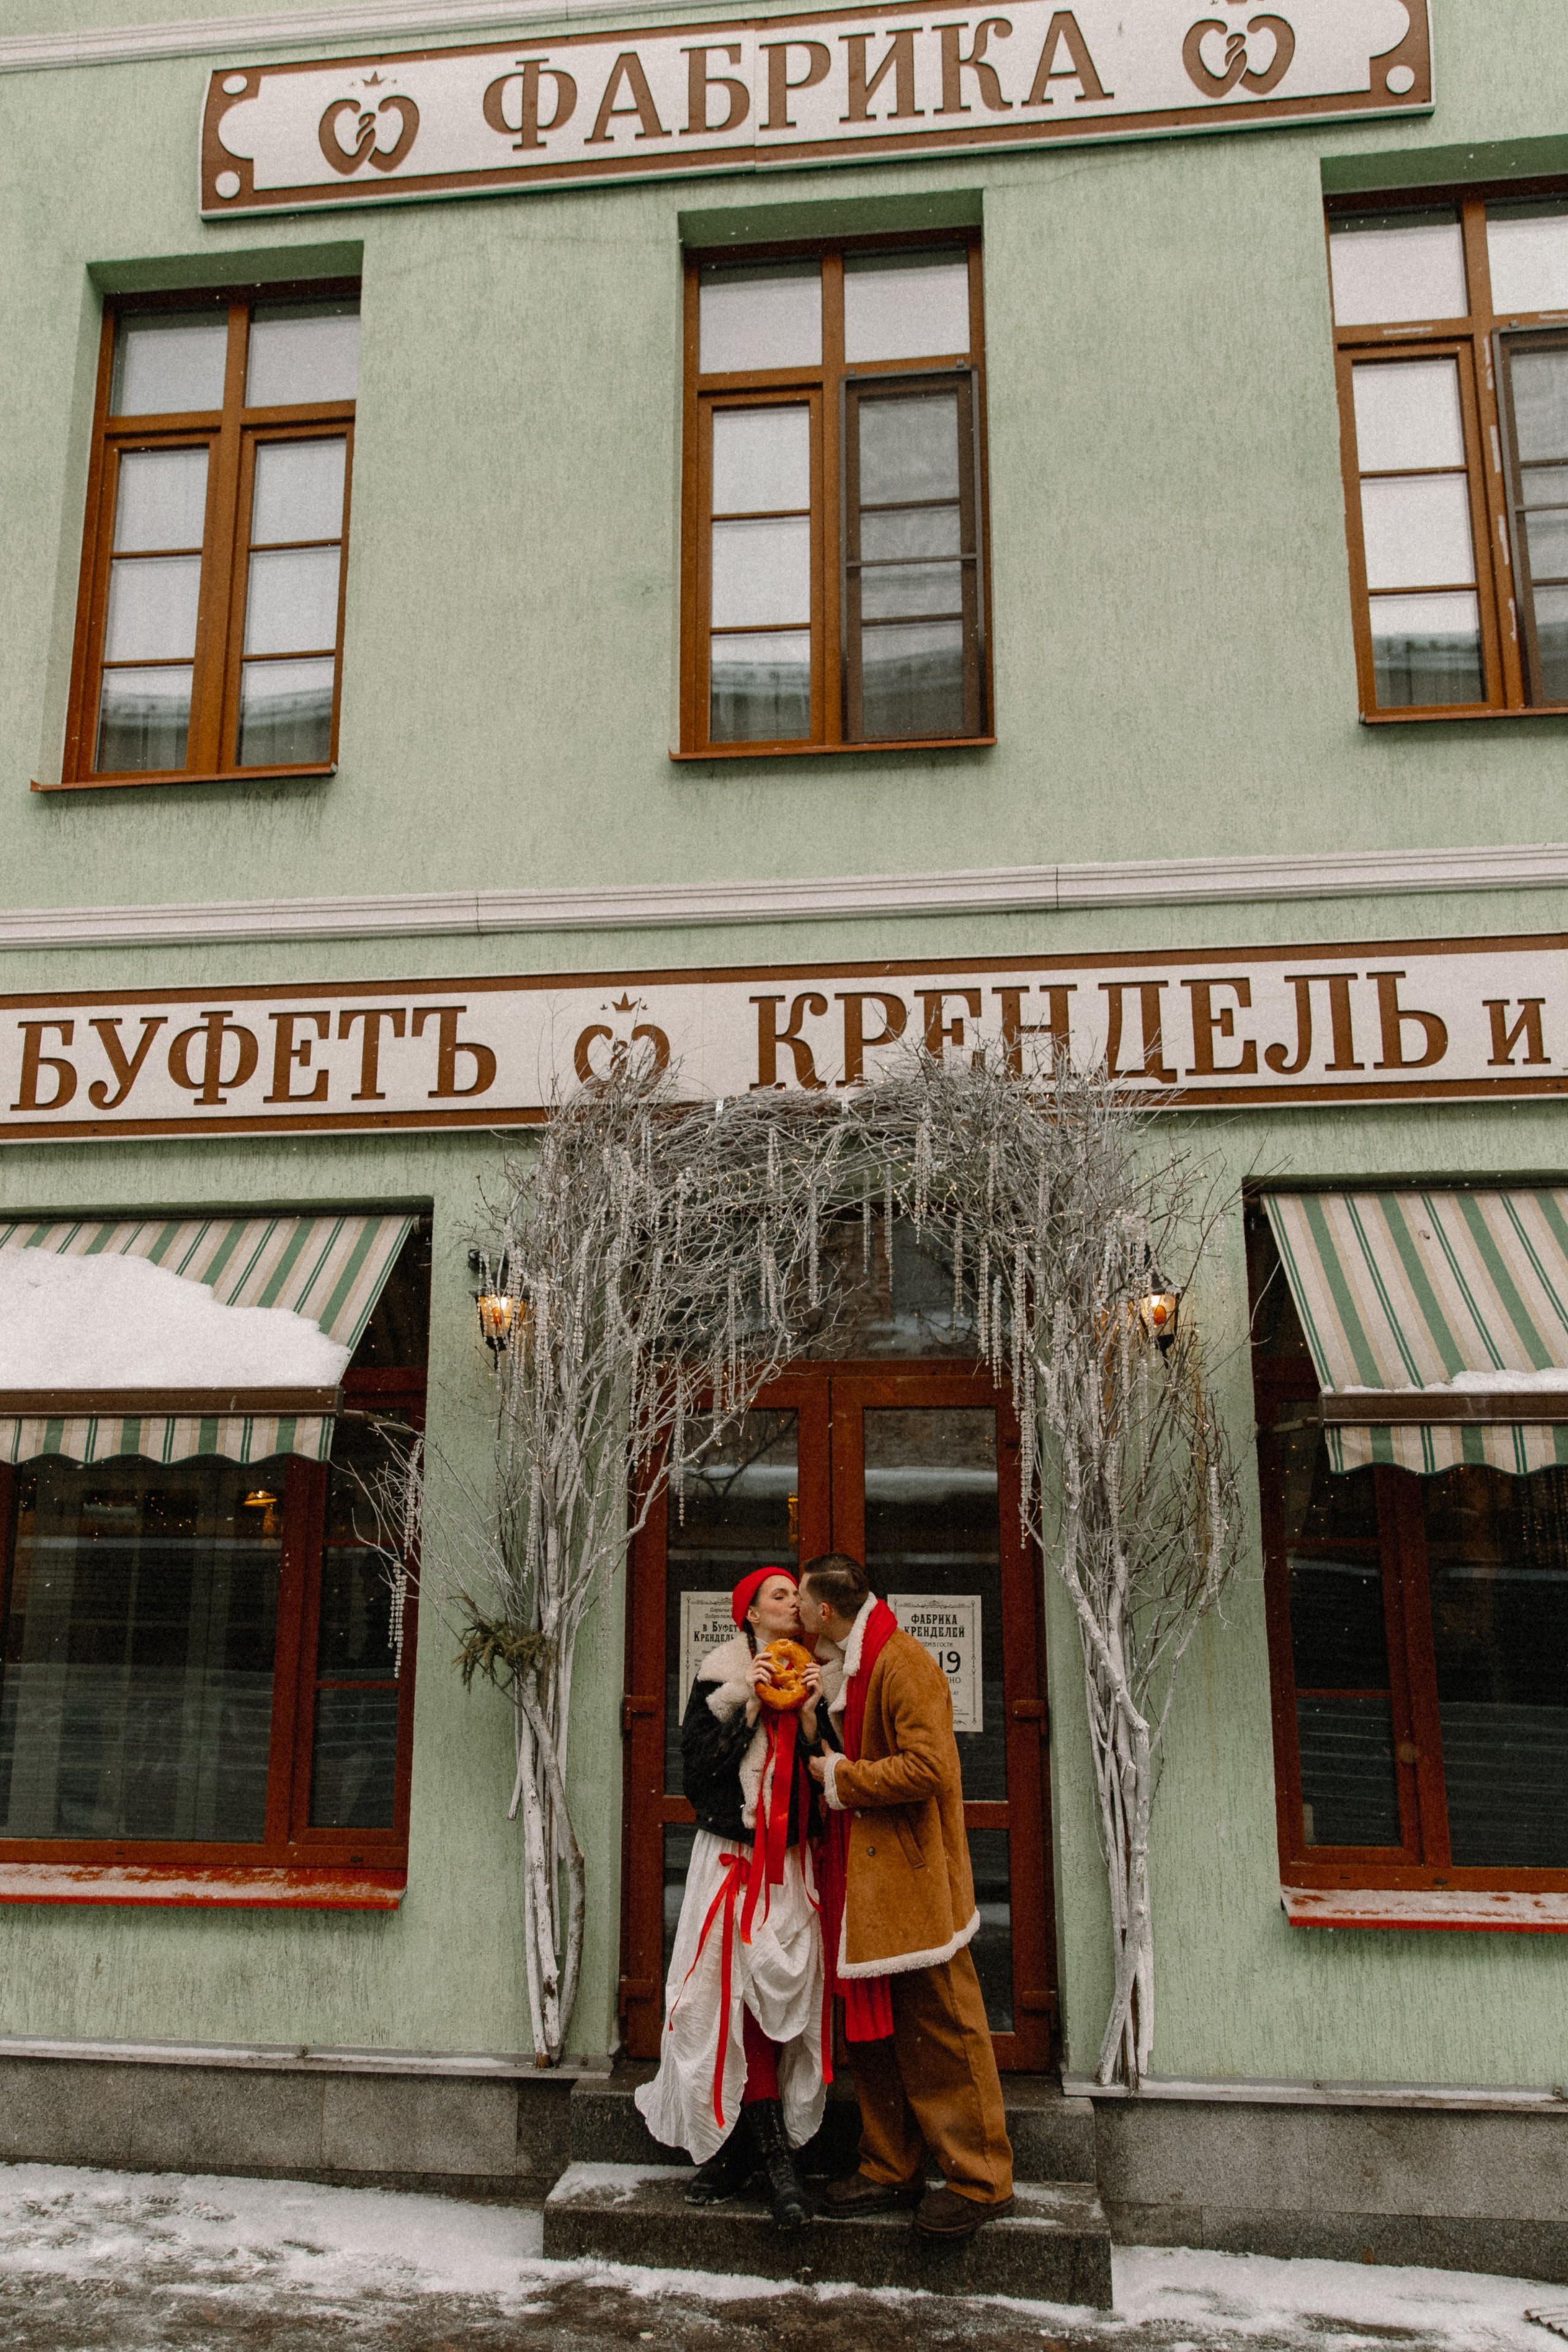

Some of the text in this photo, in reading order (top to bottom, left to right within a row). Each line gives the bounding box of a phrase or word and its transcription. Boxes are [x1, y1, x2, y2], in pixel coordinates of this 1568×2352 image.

[482, 10, 1114, 151] ФАБРИКА
[9, 1005, 497, 1111] БУФЕТЪ
[749, 971, 1449, 1091] КРЕНДЕЛЬ
[904, 1625, 965, 1638] КРЕНДЕЛЕЙ
[911, 1613, 957, 1625] ФАБРИКА
